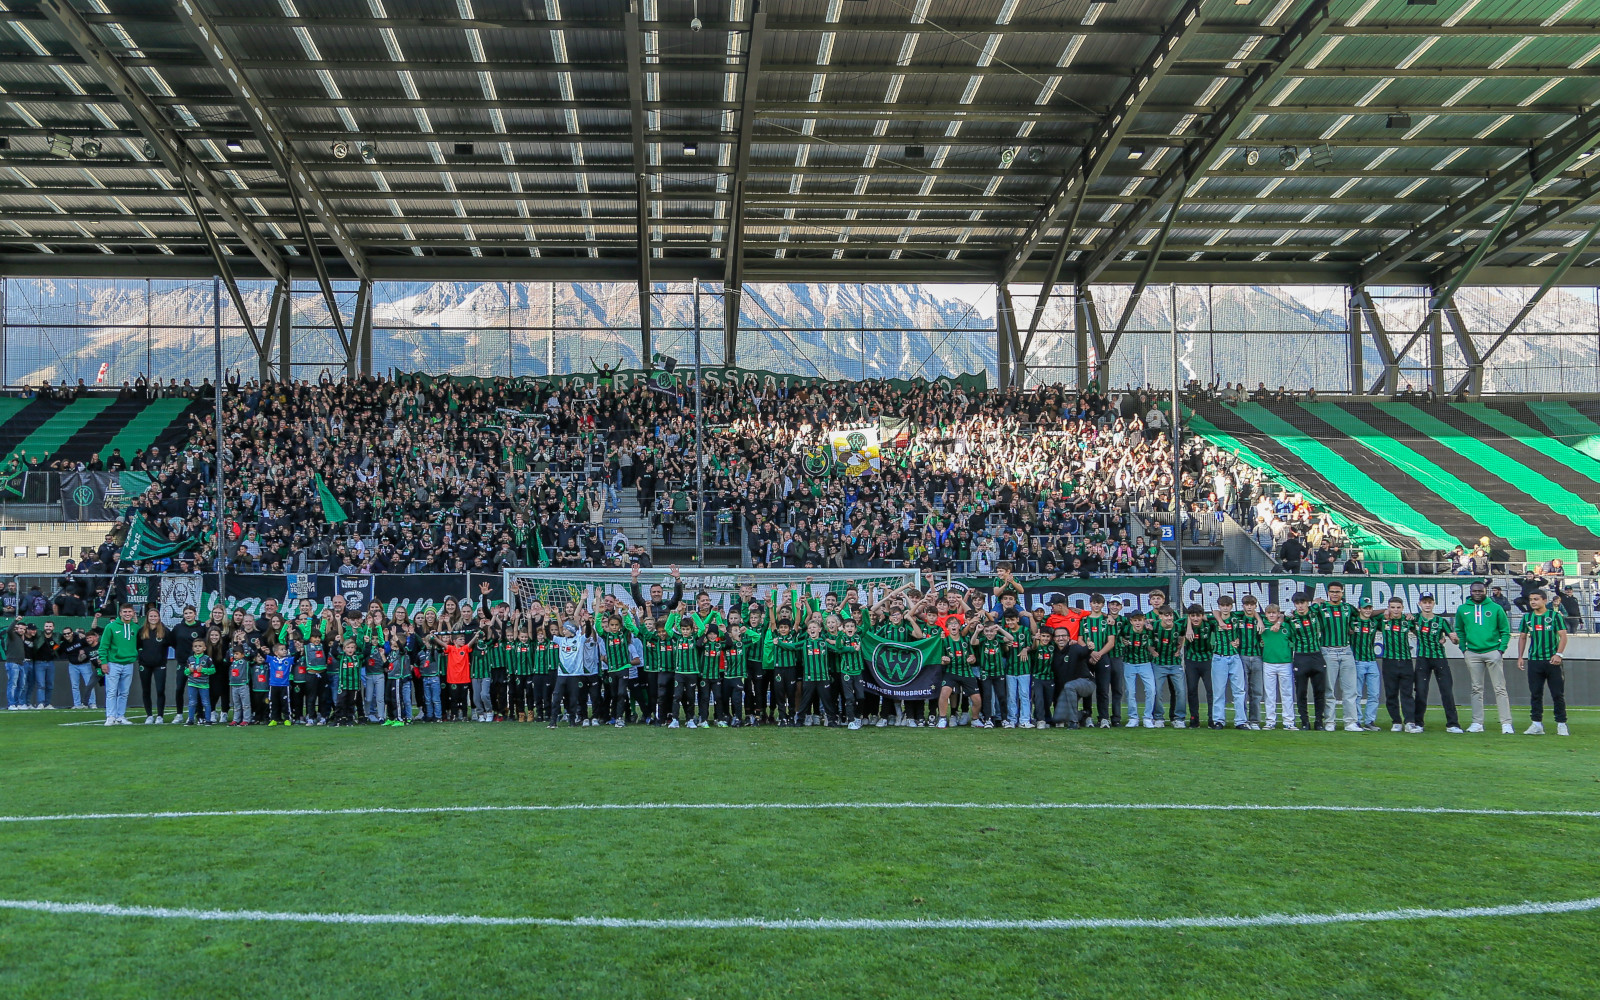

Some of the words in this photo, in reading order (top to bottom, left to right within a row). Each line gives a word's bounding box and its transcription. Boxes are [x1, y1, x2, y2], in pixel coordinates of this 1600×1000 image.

[1161, 526, 1173, 538] 23
[887, 647, 909, 664] FC
[880, 651, 916, 680] W
[866, 681, 892, 695] WACKER
[893, 689, 932, 697] INNSBRUCK
